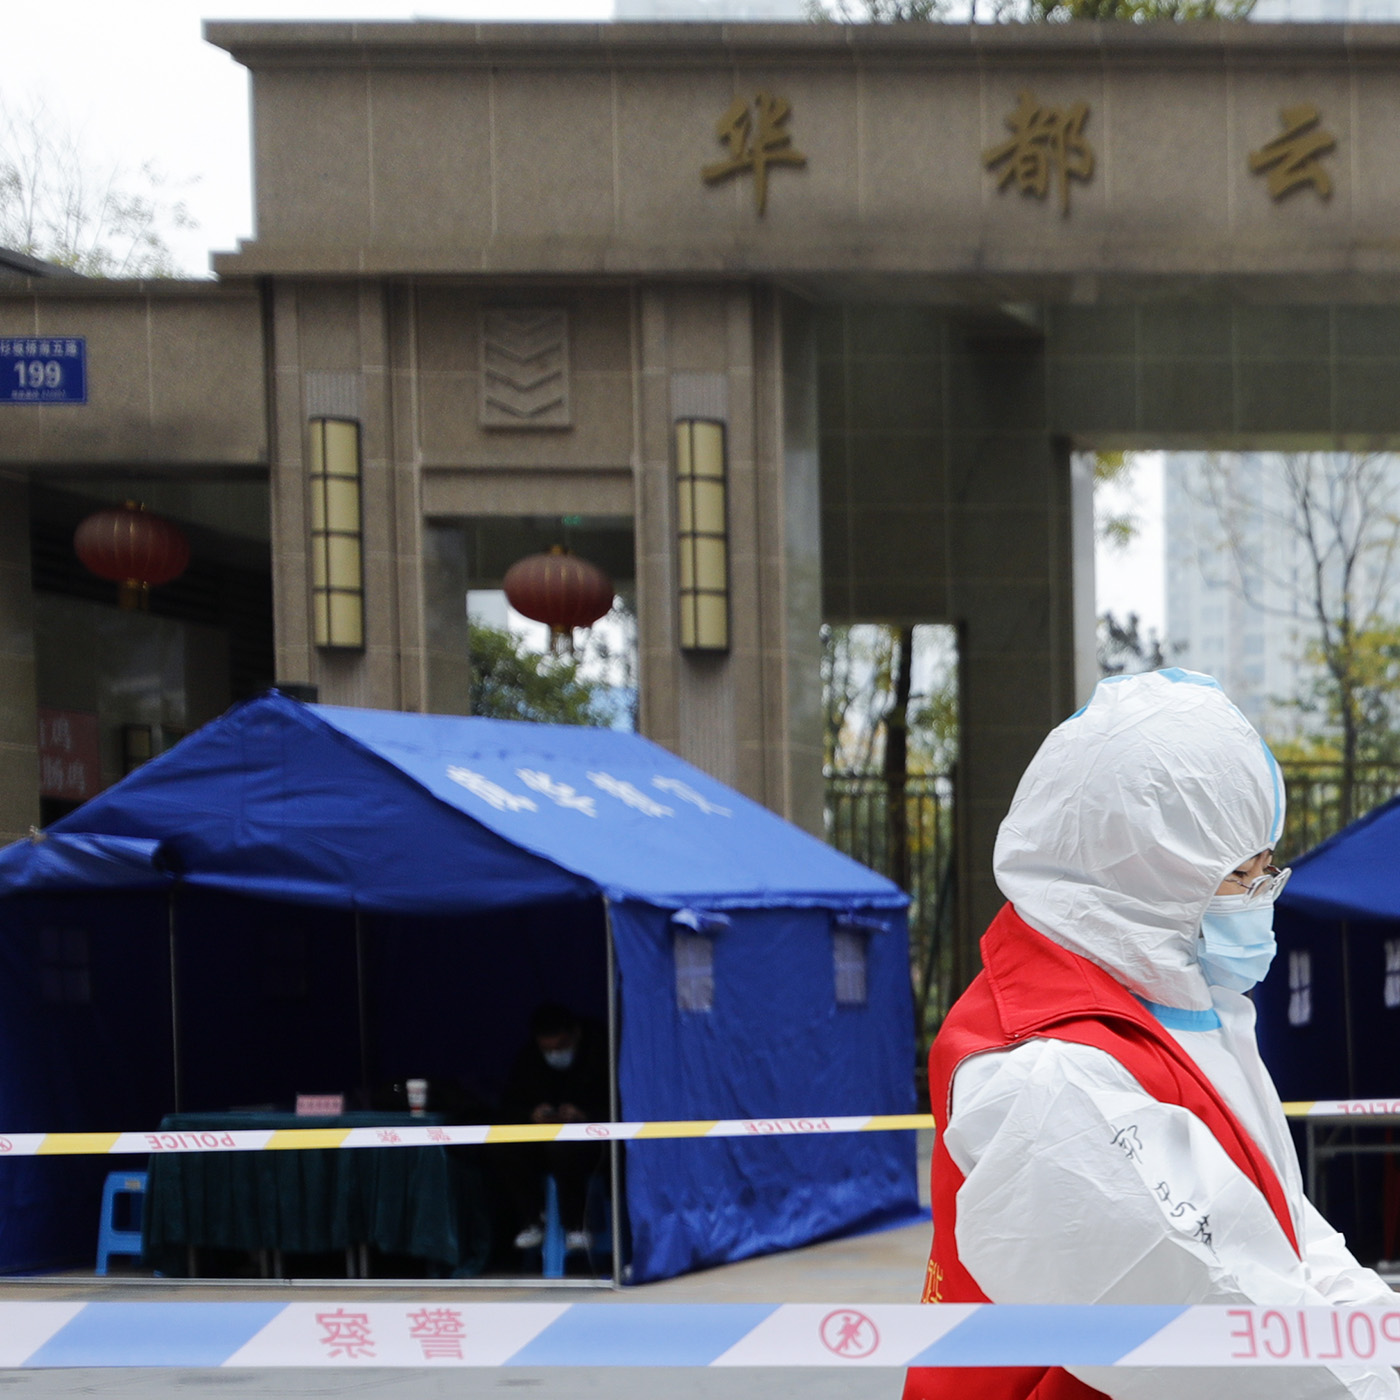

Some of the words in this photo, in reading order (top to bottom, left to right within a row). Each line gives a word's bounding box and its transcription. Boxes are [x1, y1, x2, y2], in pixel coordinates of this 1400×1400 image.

[14, 360, 61, 388] 199
[742, 1118, 831, 1135] POLICE
[145, 1131, 236, 1150] POLICE
